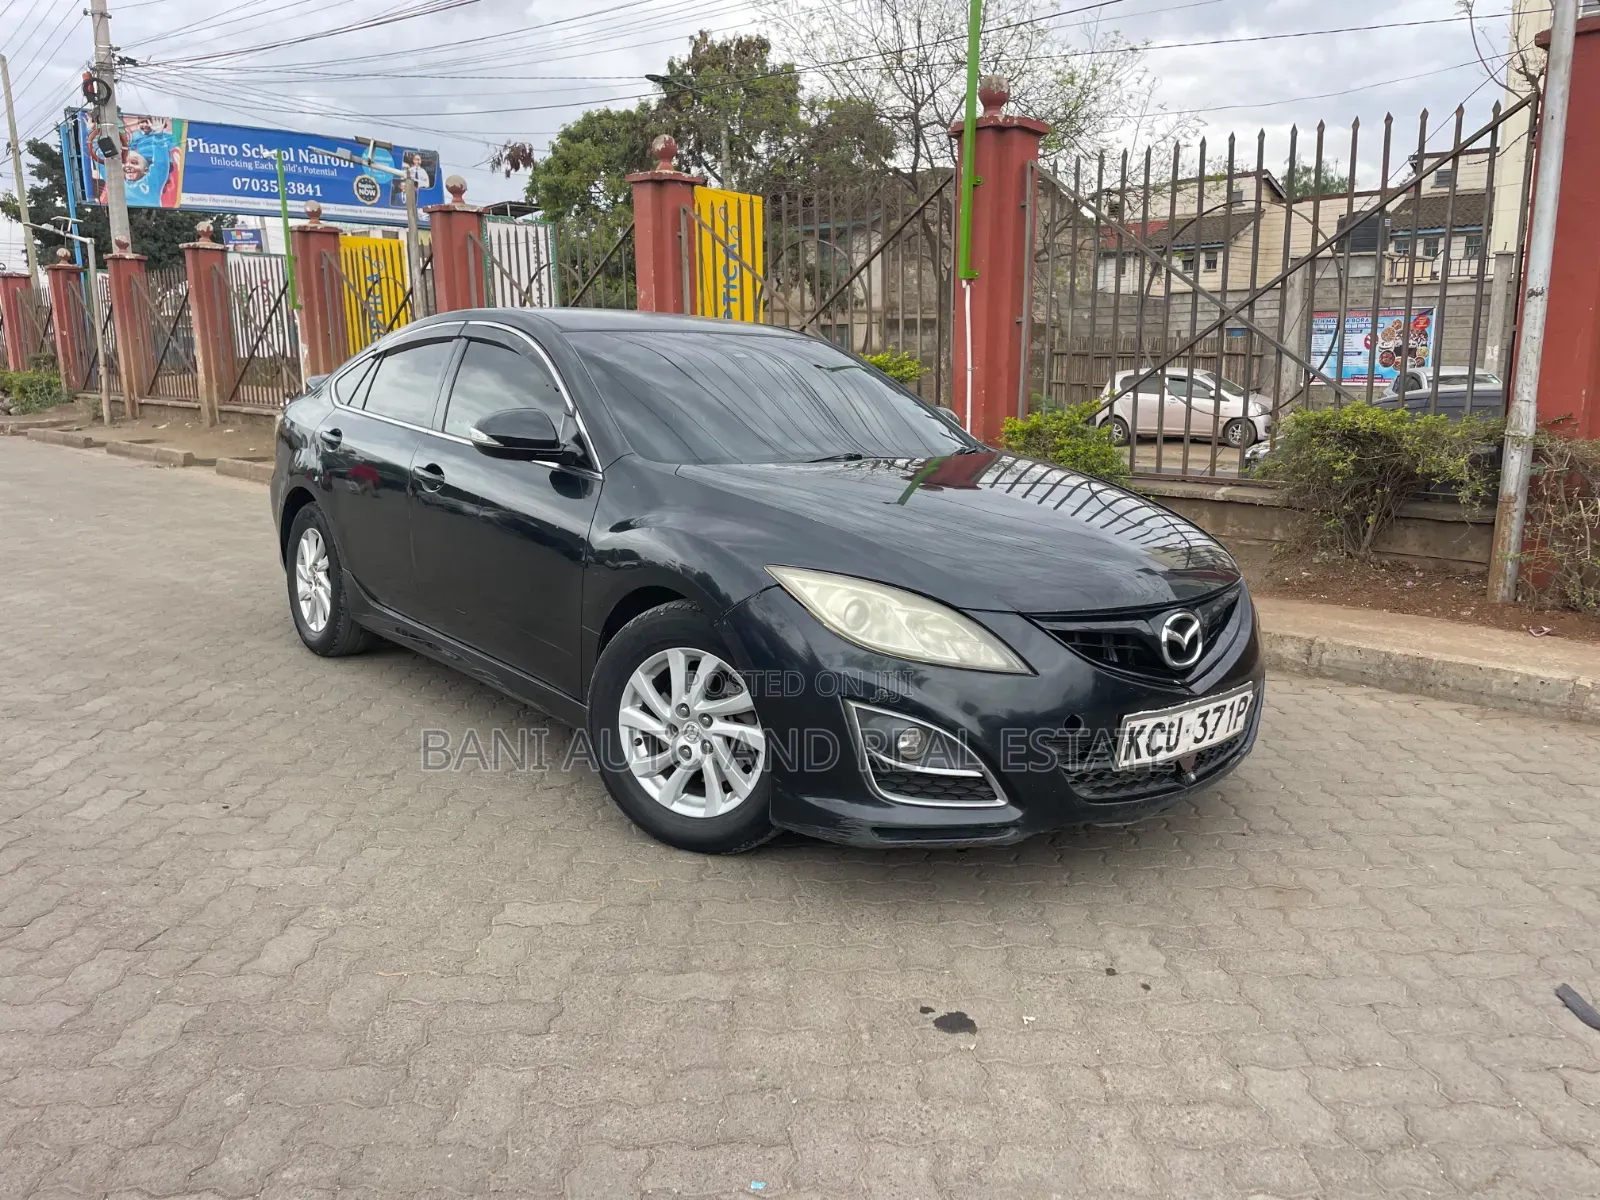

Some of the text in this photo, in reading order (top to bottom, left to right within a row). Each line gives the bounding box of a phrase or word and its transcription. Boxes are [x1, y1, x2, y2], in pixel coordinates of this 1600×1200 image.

[187, 137, 238, 157] Pharo
[210, 156, 254, 170] Unlocking
[254, 160, 274, 170] Each
[303, 165, 337, 177] Potential
[232, 176, 322, 197] 070353841
[359, 188, 376, 197] NOW
[1123, 695, 1249, 760] KCU 371P
